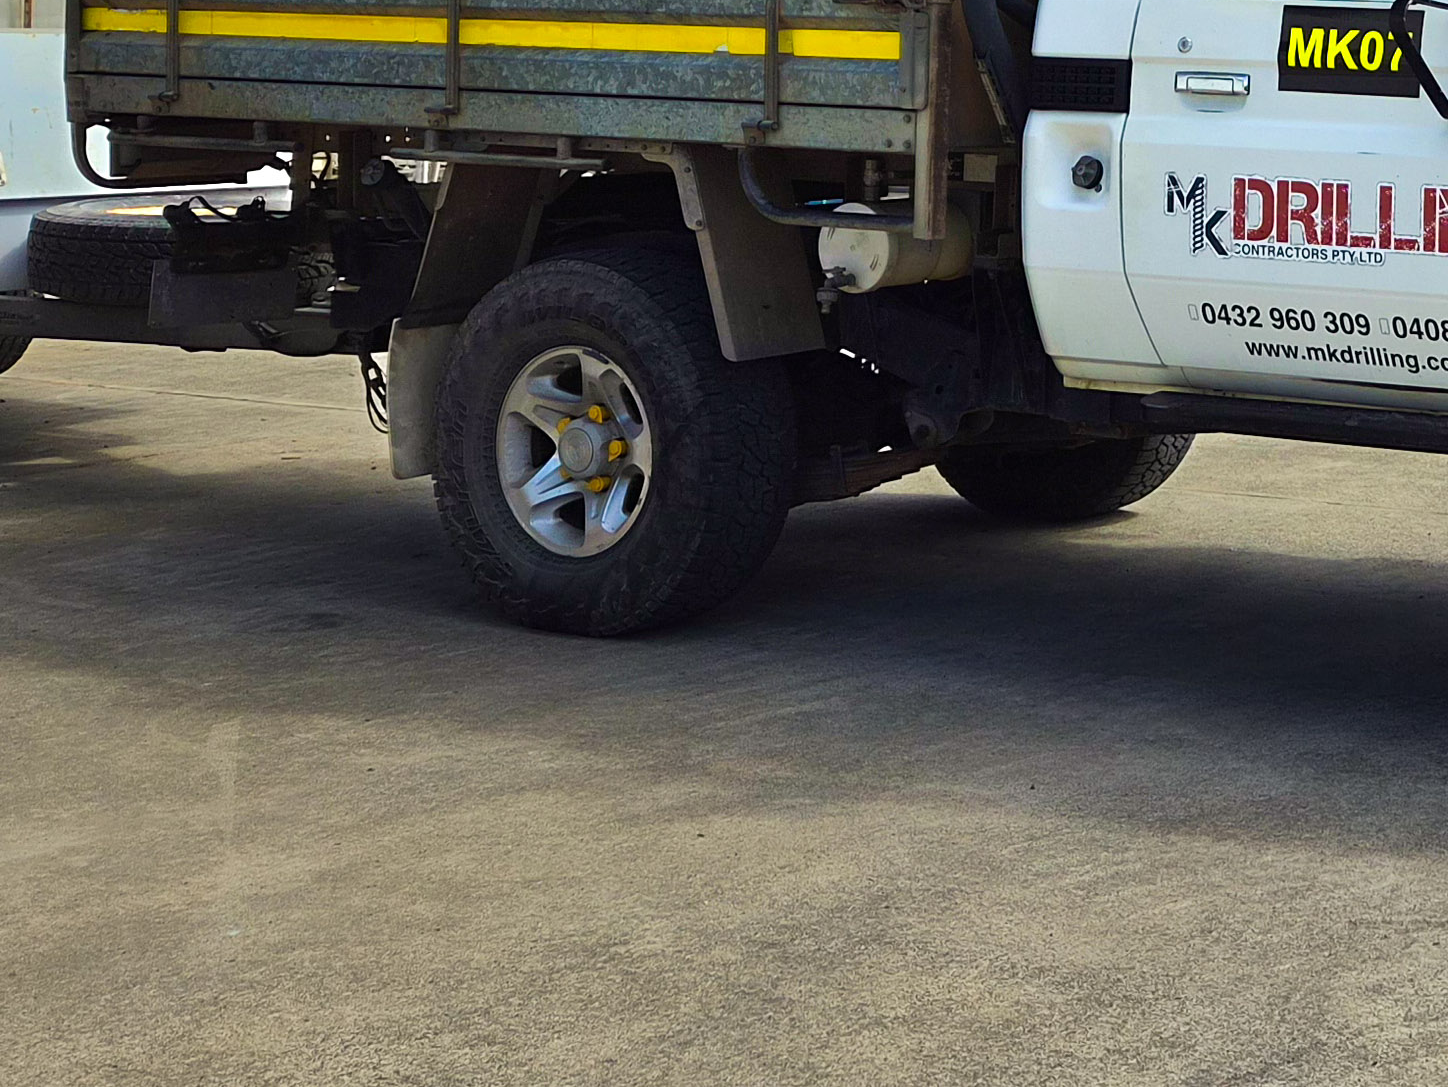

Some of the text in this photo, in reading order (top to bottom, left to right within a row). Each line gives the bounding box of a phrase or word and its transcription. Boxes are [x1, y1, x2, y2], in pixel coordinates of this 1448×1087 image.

[1165, 172, 1230, 257] MK
[1234, 243, 1384, 264] CONTRACTORS PTY LTD
[1201, 302, 1263, 328] 0432
[1269, 307, 1316, 333] 960
[1323, 311, 1371, 336] 309
